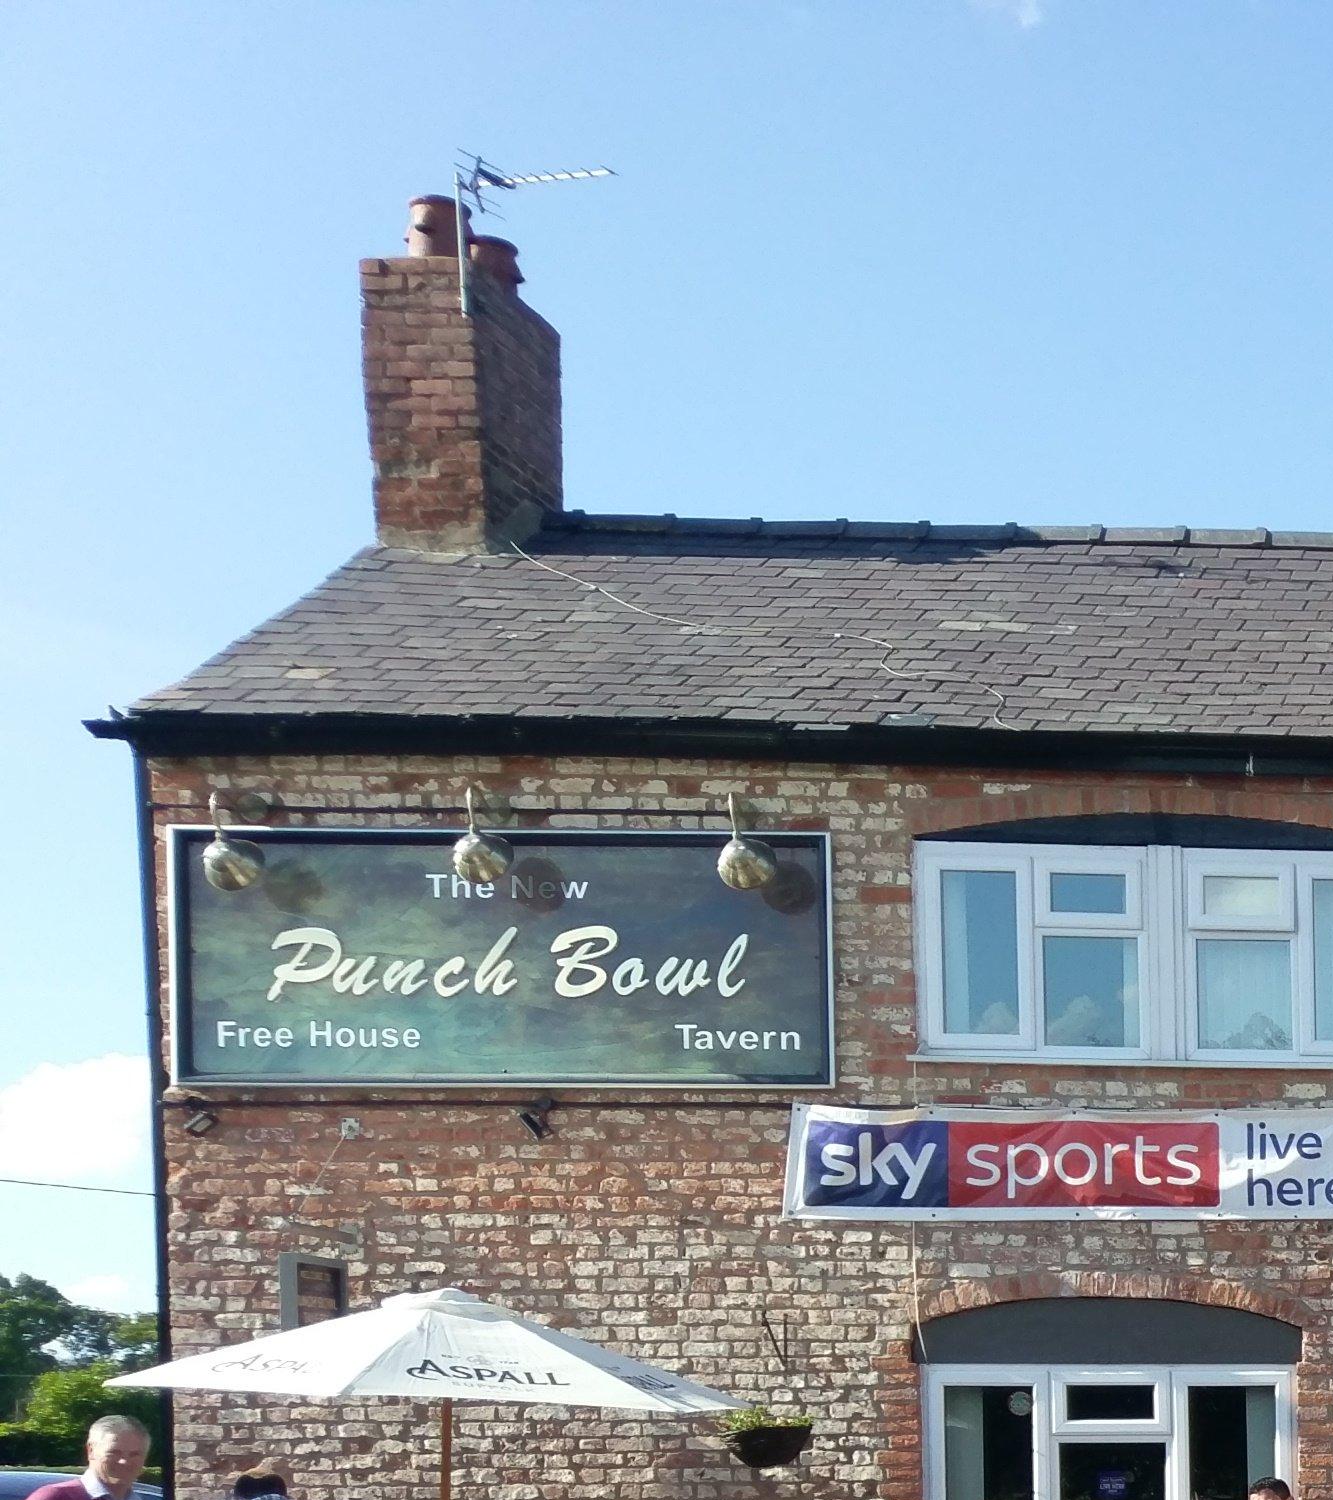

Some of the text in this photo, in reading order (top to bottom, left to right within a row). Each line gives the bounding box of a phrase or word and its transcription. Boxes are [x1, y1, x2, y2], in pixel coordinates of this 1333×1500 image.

[425, 873, 588, 899] The New
[266, 925, 749, 1002] Punch Bowl
[216, 1020, 421, 1048] Free House
[674, 1023, 801, 1051] Tavern
[1246, 1122, 1323, 1160] live
[820, 1132, 1201, 1200] sky sports
[406, 1359, 571, 1387] ASPALL
